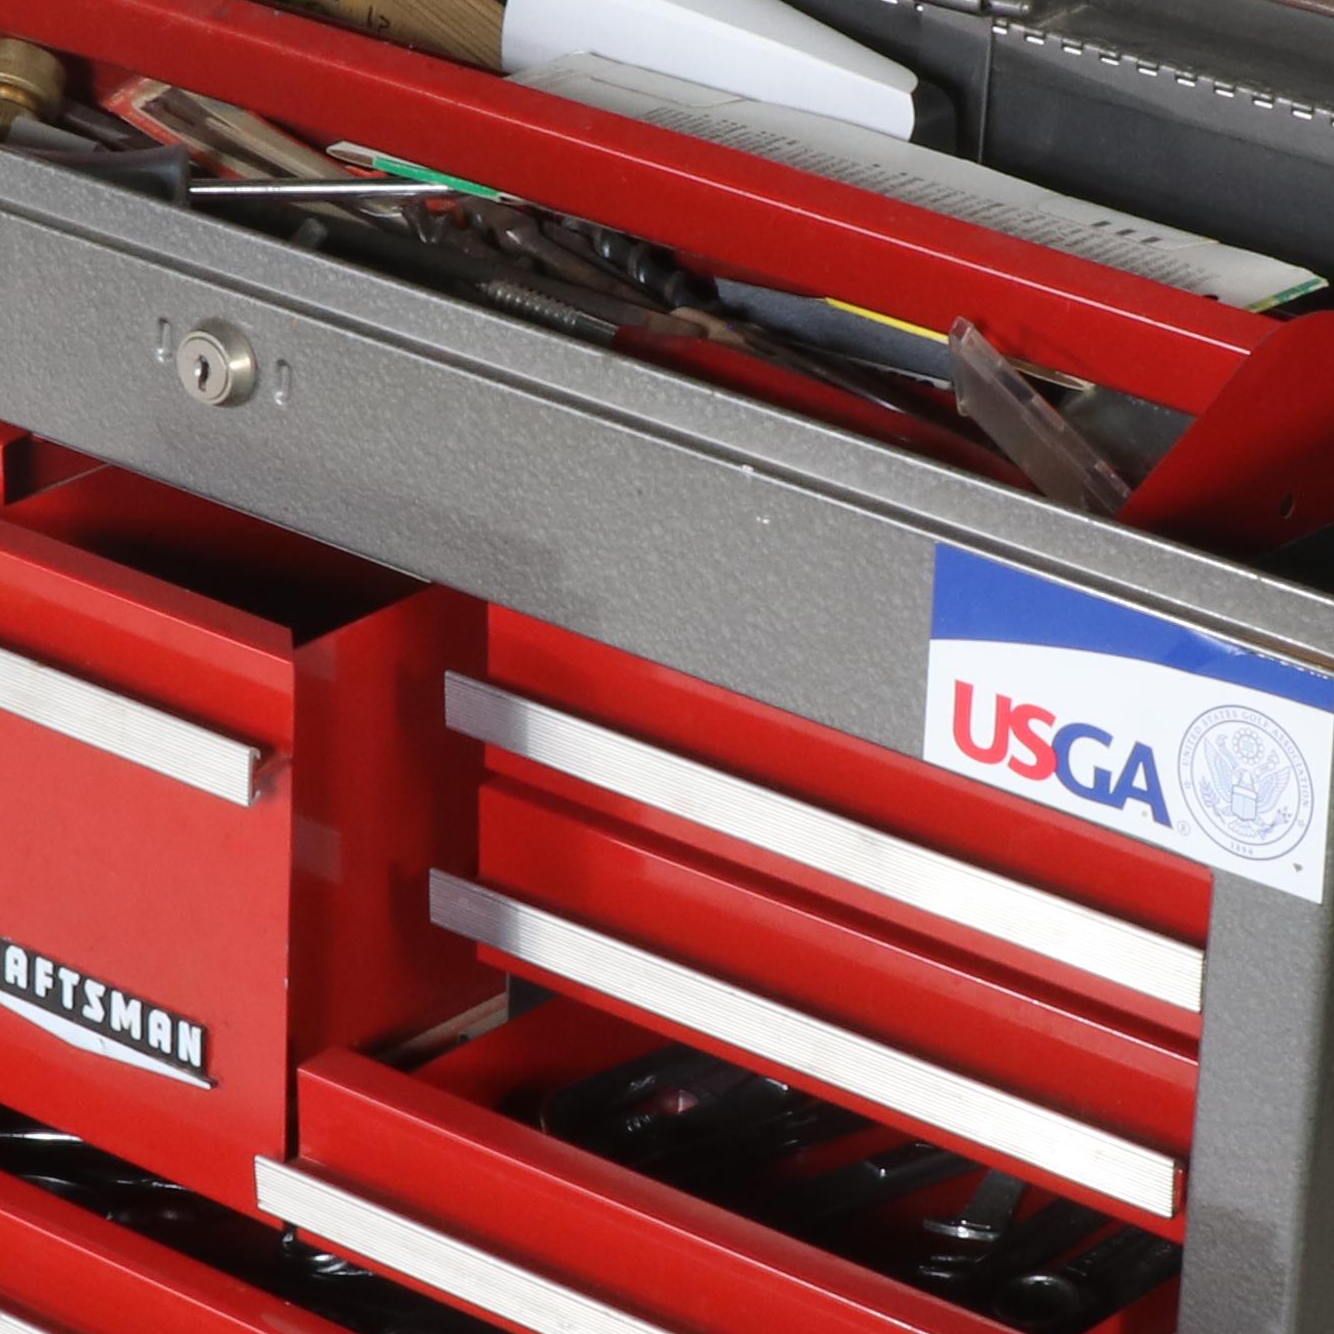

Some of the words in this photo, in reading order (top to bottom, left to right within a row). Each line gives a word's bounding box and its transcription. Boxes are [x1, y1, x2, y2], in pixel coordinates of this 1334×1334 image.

[953, 679, 1173, 829] USGA
[1181, 725, 1203, 767] UNITED
[1201, 709, 1238, 728] STATES
[1241, 710, 1270, 729] GOLF
[1271, 728, 1310, 808] ASSOCIATION
[1229, 841, 1255, 857] 1894
